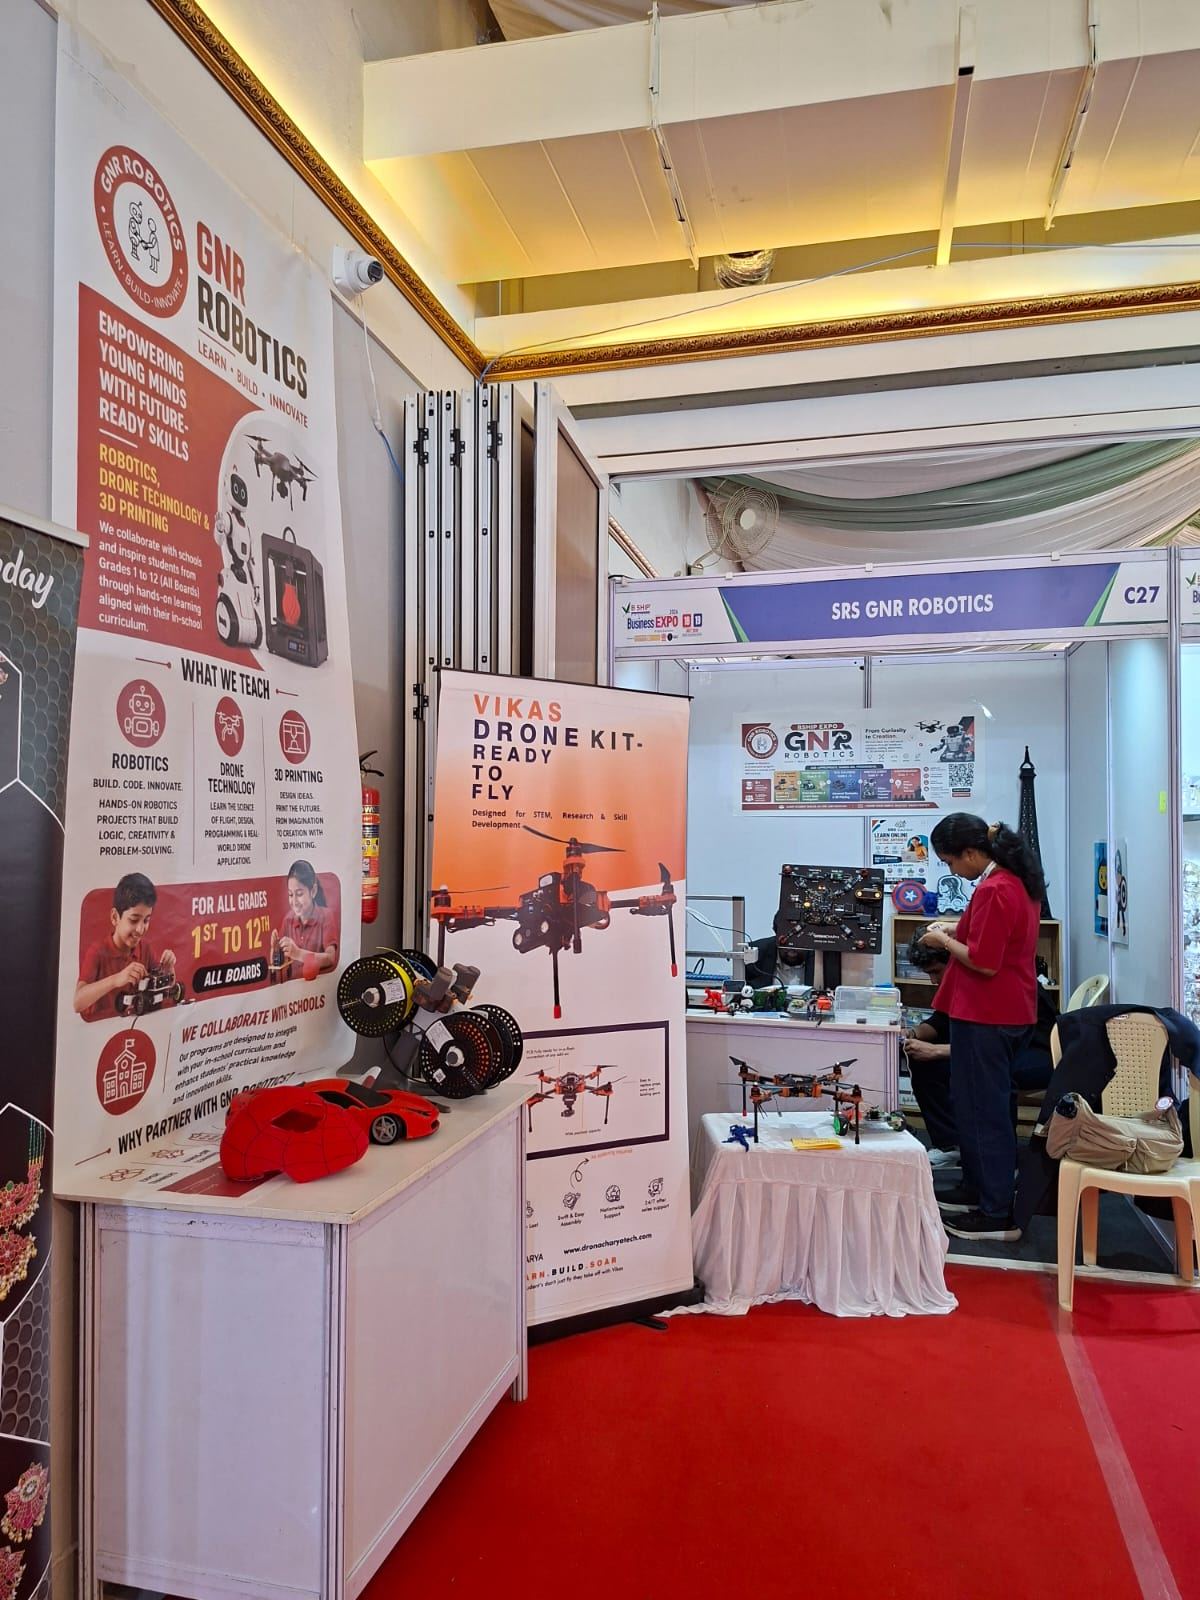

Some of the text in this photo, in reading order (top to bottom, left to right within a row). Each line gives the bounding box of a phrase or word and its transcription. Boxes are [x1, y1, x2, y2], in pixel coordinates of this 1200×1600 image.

[101, 154, 182, 251] GNR ROBOTICS
[103, 222, 183, 309] LEARN BUILD INNOVATE
[197, 221, 245, 307] GNR
[99, 310, 184, 382] EMPOWERING
[198, 275, 307, 400] ROBOTICS
[99, 338, 187, 409] YOUNG MINDS
[198, 340, 308, 428] LEARN BUILD INNOVATE
[99, 368, 189, 434] WITH FUTURE-
[100, 396, 189, 462] READY SKILLS
[99, 443, 160, 489] ROBOTICS,
[99, 467, 210, 531] DRONE TECHNOLOGY &
[99, 492, 169, 533] 3D PRINTING
[99, 520, 203, 567] We collaborate with schools
[99, 541, 196, 581] and inspire students from
[0, 549, 54, 609] day
[99, 557, 200, 599] Grades 1 to 12 (All Boards)
[99, 575, 202, 616] through hands-on learning
[831, 593, 995, 621] SRS GNR ROBOTICS
[1123, 585, 1161, 606] C27
[99, 593, 203, 630] aligned with their in-school
[99, 613, 149, 632] curriculum.
[627, 617, 655, 630] Business
[655, 615, 679, 628] EXPO
[181, 657, 270, 700] WHAT WE TEACH
[473, 693, 562, 722] VIKAS
[473, 719, 644, 751] DRONE KIT-
[784, 730, 853, 752] GNR
[112, 753, 169, 772] ROBOTICS
[473, 744, 552, 764] READY
[784, 751, 854, 759] ROBOTICS
[220, 762, 244, 778] DRONE
[274, 768, 323, 783] 3D PRINTING
[472, 764, 503, 781] TO
[93, 778, 183, 791] BUILD. CODE. INNOVATE.
[208, 778, 255, 795] TECHNOLOGY
[472, 783, 514, 800] FLY
[99, 799, 178, 810] HANDS-ON ROBOTICS
[210, 802, 255, 811] LEARN THE SCIENCE
[472, 809, 506, 819] Designed
[516, 810, 526, 818] for
[533, 811, 553, 820] STEM,
[562, 812, 594, 820] Research
[613, 813, 628, 821] Skill
[97, 815, 179, 825] PROJECTS THAT BUILD
[288, 817, 324, 825] IMAGINATION
[472, 820, 521, 829] Development
[98, 830, 176, 841] LOGIC, CREATIVITY &
[204, 830, 243, 838] PROGRAMMING
[283, 829, 307, 837] CREATION
[99, 845, 174, 856] PROBLEM-SOLVING.
[217, 843, 251, 852] WORLD DRONE
[192, 890, 268, 916] FOR ALL GRADES
[191, 915, 270, 959] 1ST TO 12TH
[203, 963, 262, 987] ALL BOARDS
[182, 995, 326, 1044] WE COLLABORATE WITH SCHOOLS
[177, 1040, 286, 1077] with your in-school curriculum and
[179, 1031, 275, 1063] Our programs are designed to
[175, 1050, 297, 1091] enhance students' practical knowledge
[172, 1074, 233, 1105] and innovation skills.
[118, 1100, 218, 1155] WHY PARTNER WITH
[600, 1205, 625, 1213] Nationwide
[604, 1212, 621, 1220] Support
[653, 1204, 670, 1212] support
[561, 1219, 582, 1227] Assembly
[563, 1232, 653, 1256] www.dronacharyatech.com
